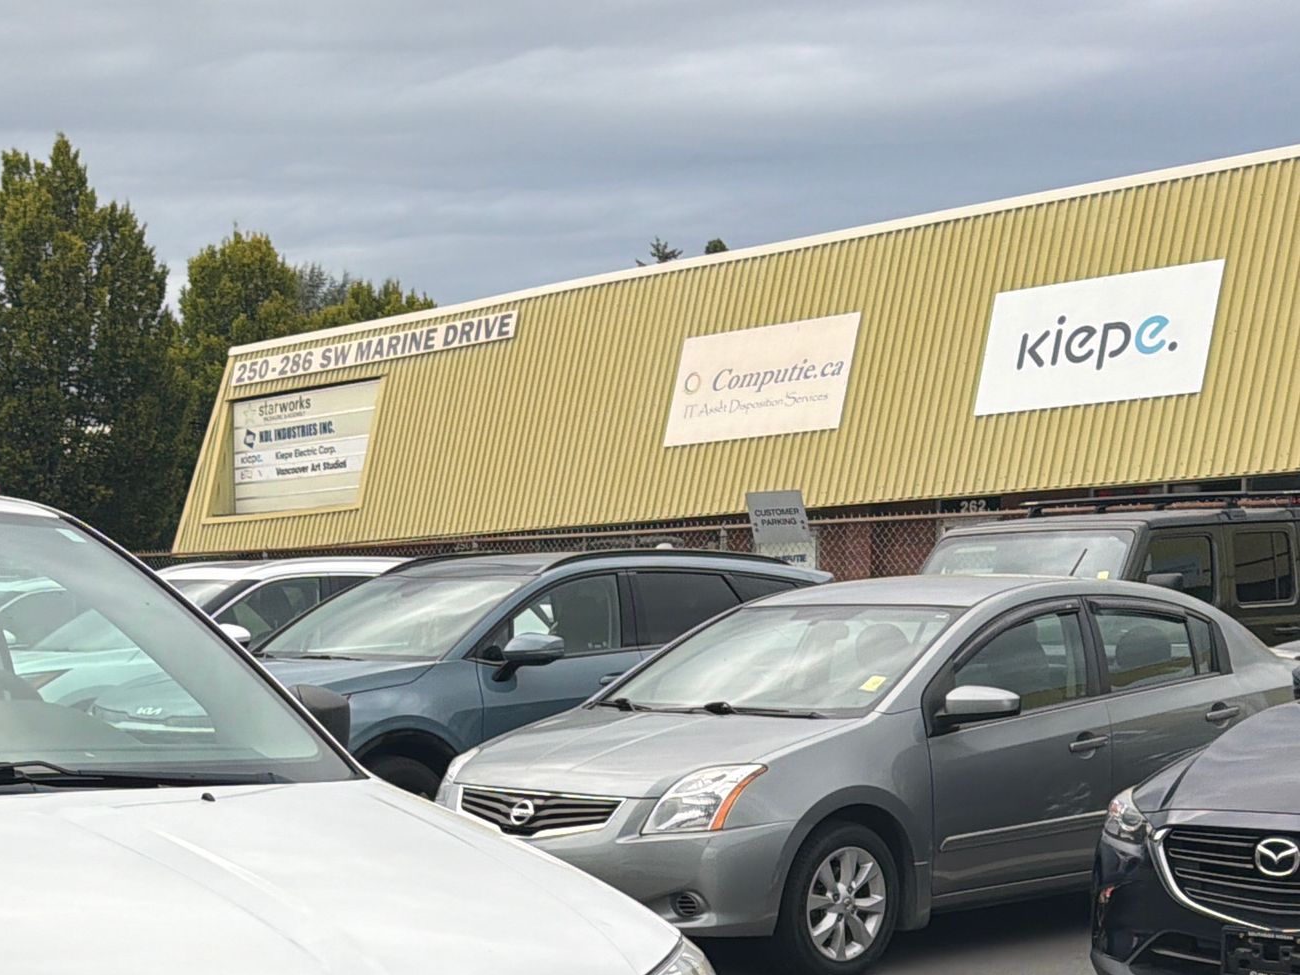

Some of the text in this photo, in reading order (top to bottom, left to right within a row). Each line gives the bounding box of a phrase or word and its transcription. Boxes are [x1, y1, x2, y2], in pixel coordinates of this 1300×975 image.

[235, 313, 513, 384] 250-286 SW MARINE DRIVE
[712, 358, 845, 393] Computie.ca
[258, 395, 311, 417] starworks
[274, 423, 318, 441] INDUSTRIES
[319, 420, 335, 435] INC.
[294, 446, 317, 458] Electric
[318, 445, 336, 456] Corp.
[311, 463, 321, 472] Art
[754, 507, 800, 517] CUSTOMER
[959, 499, 987, 513] 262
[761, 517, 798, 526] PARKING
